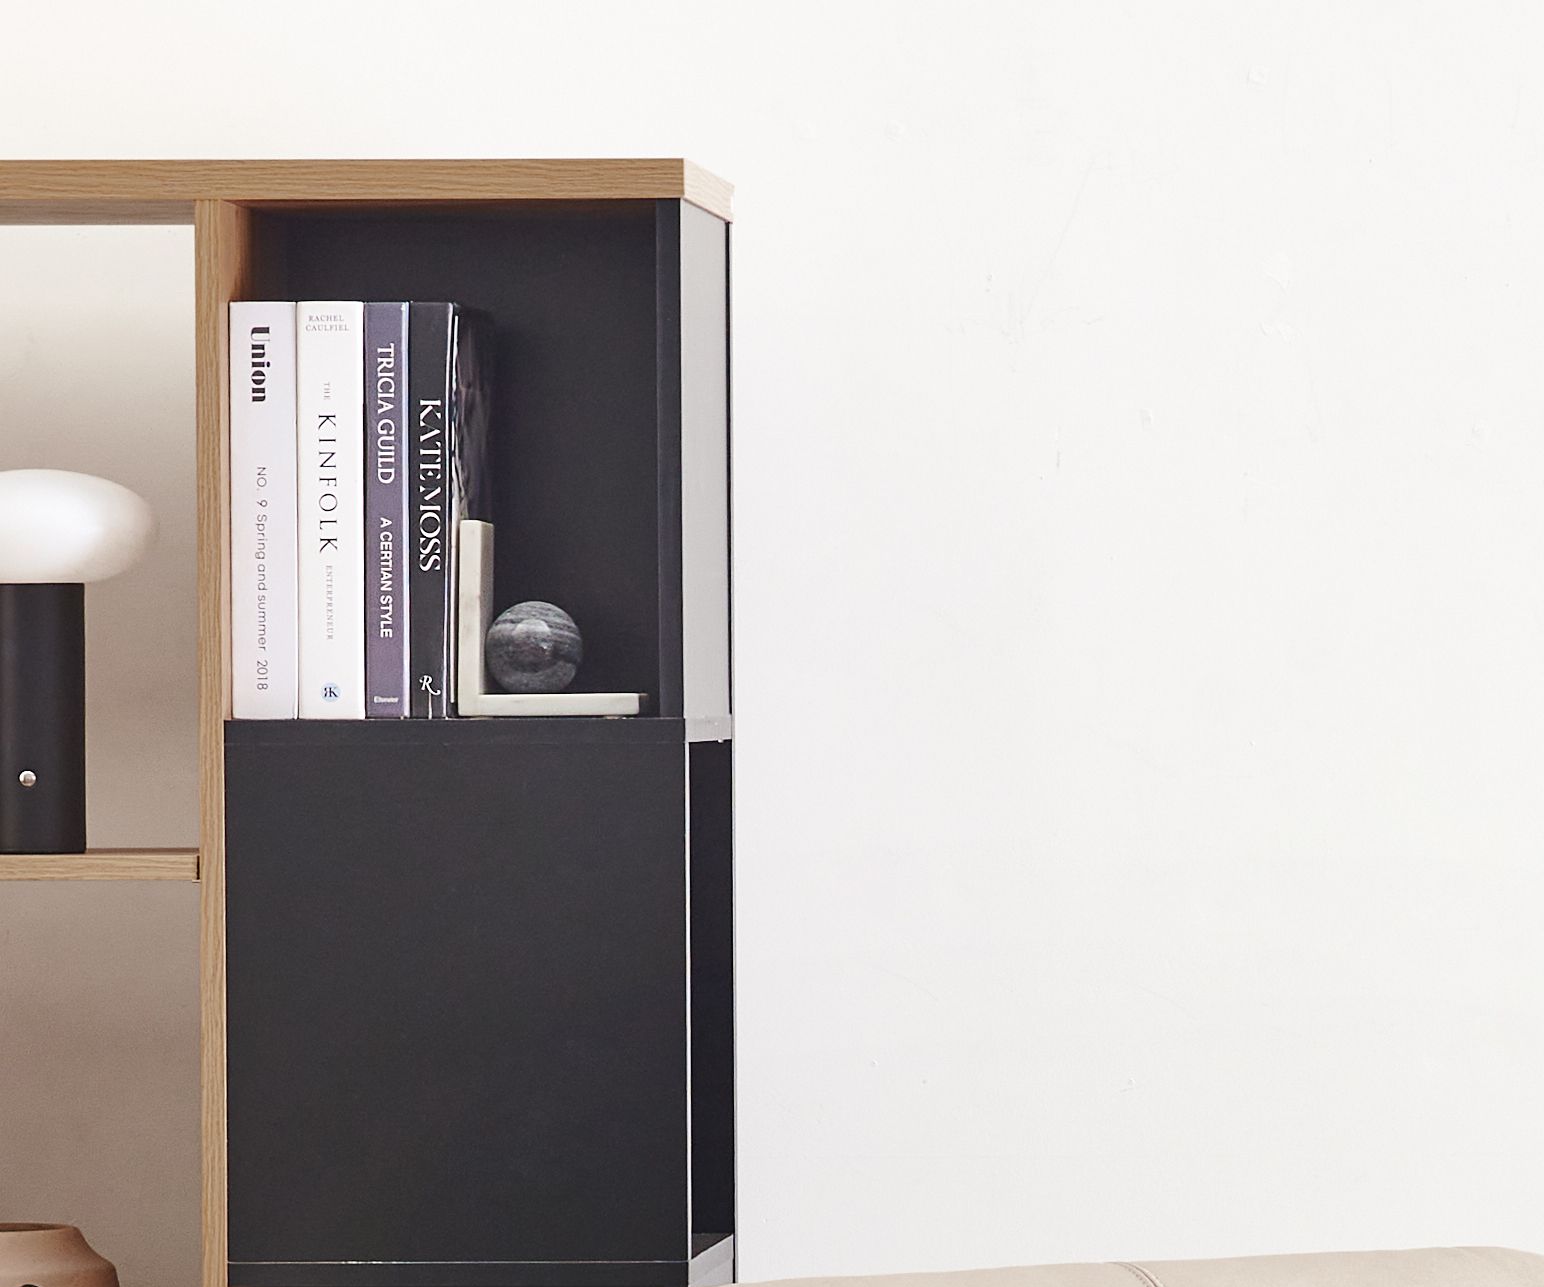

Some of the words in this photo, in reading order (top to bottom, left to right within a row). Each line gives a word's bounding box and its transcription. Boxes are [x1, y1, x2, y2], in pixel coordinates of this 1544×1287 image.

[250, 326, 271, 402] Union
[376, 343, 395, 414] TRICIA
[377, 418, 395, 484] GUILD
[419, 400, 442, 481] KATE
[256, 466, 267, 491] NO.
[256, 499, 268, 508] 9
[318, 414, 338, 553] KINFOLK
[255, 514, 268, 560] Spring
[380, 517, 393, 528] A
[419, 485, 442, 572] MOSS
[257, 563, 268, 591] and
[380, 531, 393, 592] CERTIAN
[257, 594, 266, 651] summer
[380, 594, 393, 638] STYLE
[256, 660, 269, 691] 2018
